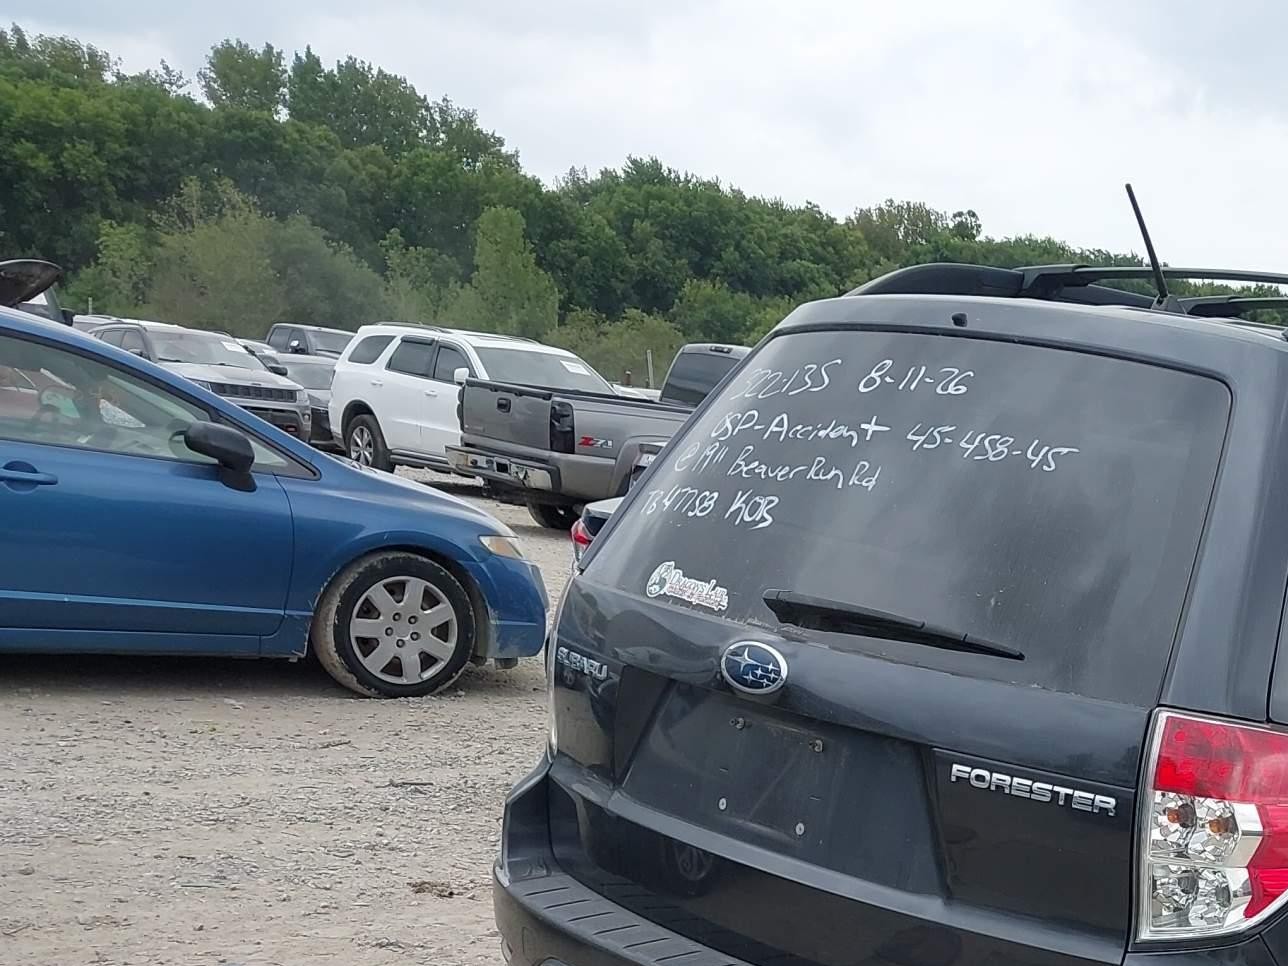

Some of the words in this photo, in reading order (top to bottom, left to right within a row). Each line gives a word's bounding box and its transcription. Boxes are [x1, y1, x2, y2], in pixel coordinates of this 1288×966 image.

[858, 359, 974, 395] 8-11-26
[727, 445, 808, 482] Beaver
[806, 456, 844, 489] Run
[848, 460, 882, 493] Rd
[906, 423, 1080, 471] 45-458-45
[557, 646, 608, 681] SUBARU
[950, 763, 1117, 817] FORESTER
